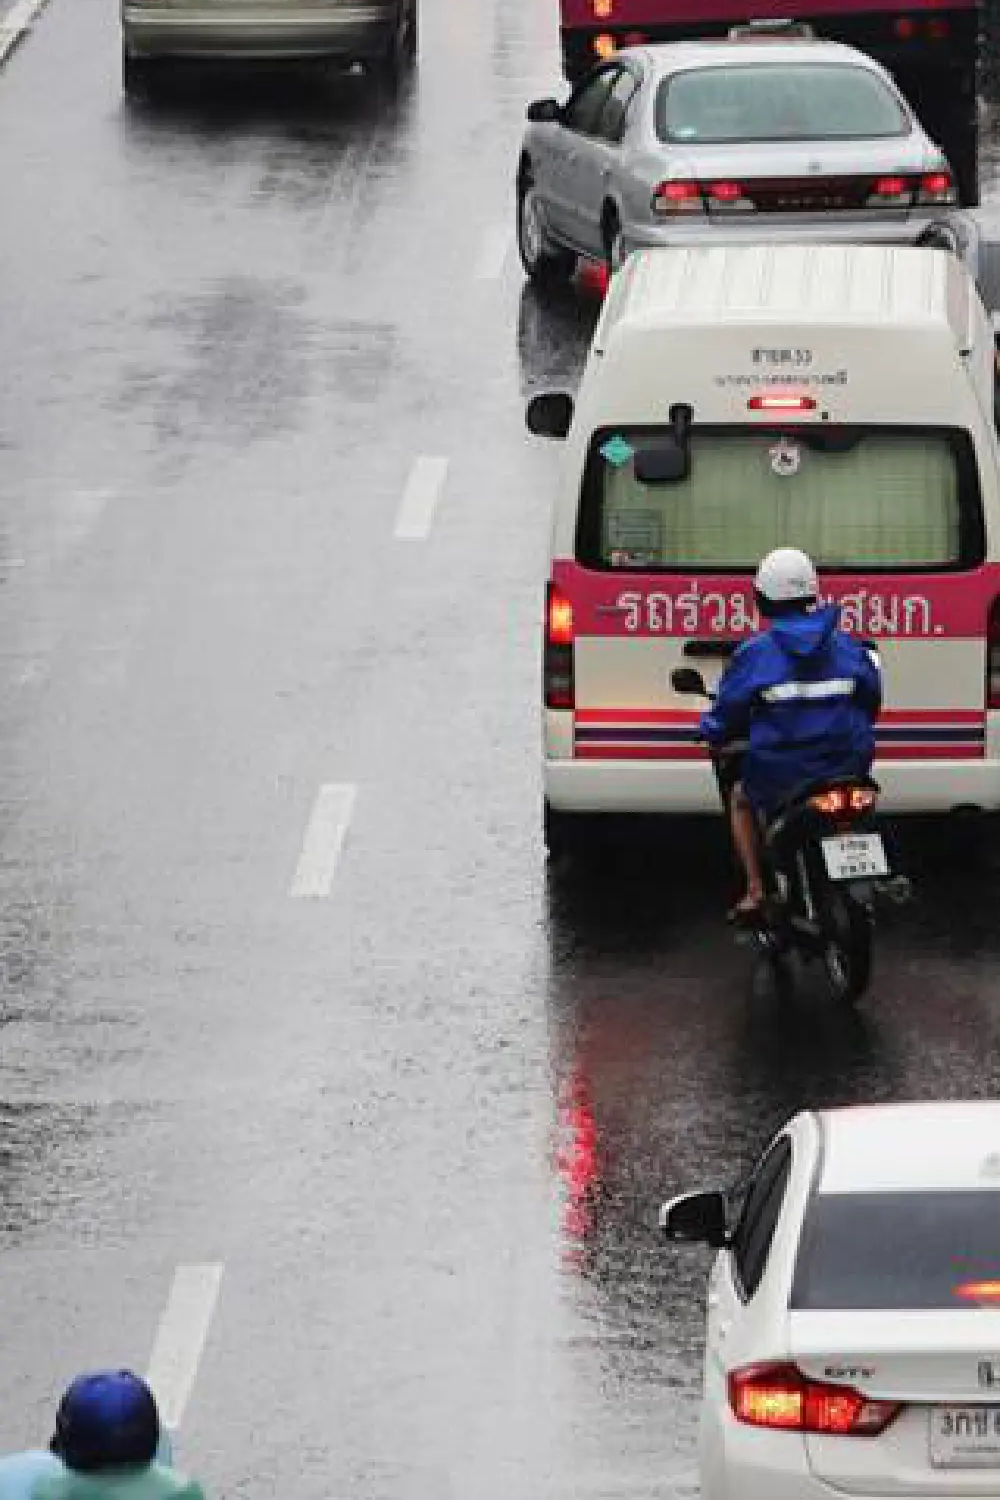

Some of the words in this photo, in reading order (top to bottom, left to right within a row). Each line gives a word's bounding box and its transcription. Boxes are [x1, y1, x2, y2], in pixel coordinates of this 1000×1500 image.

[616, 578, 760, 633] รถร่วม
[808, 588, 944, 635] สมก.
